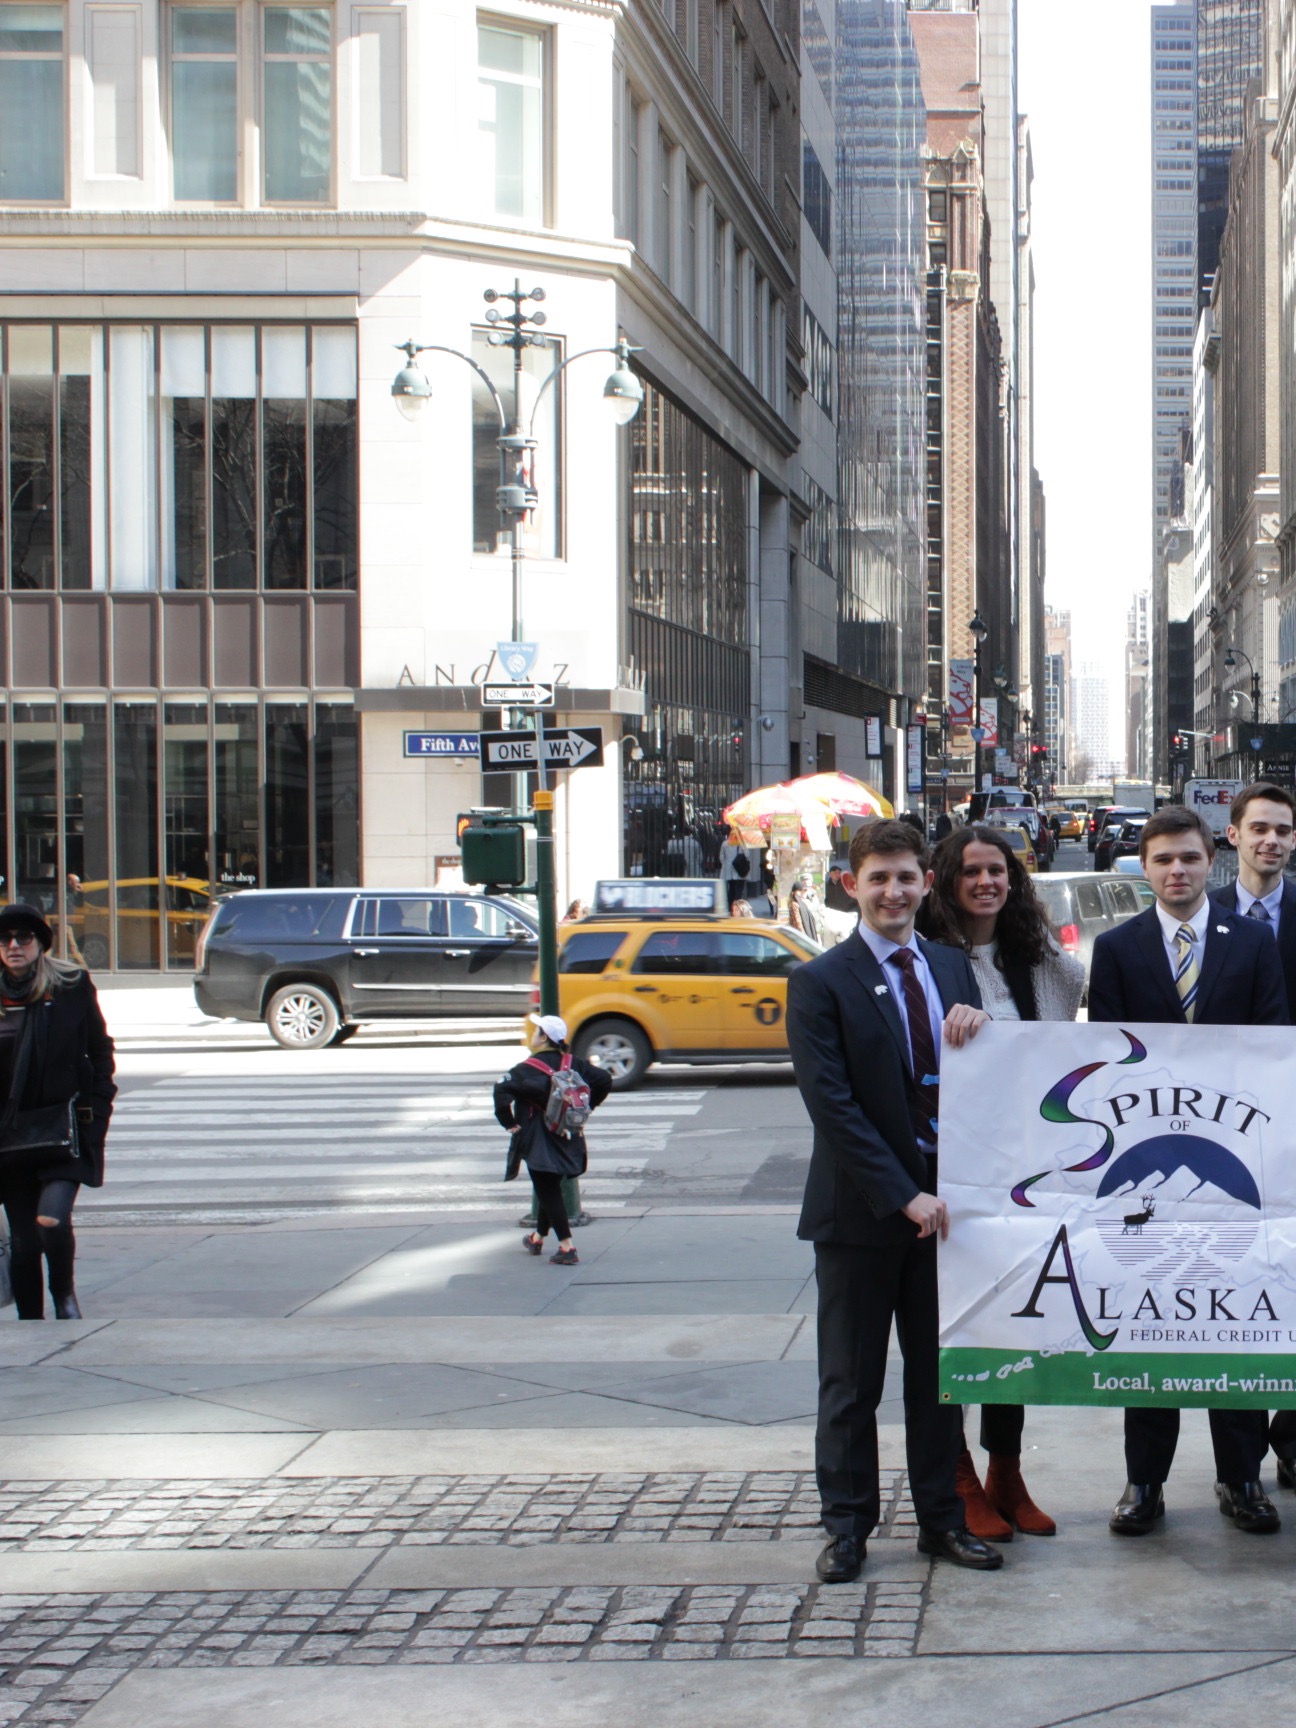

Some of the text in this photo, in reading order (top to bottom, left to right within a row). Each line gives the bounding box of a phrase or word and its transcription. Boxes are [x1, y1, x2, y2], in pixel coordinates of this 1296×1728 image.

[489, 689, 544, 698] ONE WAY
[420, 738, 480, 751] Fifth Av
[498, 741, 584, 760] ONE WAY
[221, 872, 256, 884] the shop
[1170, 1120, 1191, 1132] OF
[1011, 1224, 1281, 1351] ALASKA
[1129, 1329, 1211, 1342] FEDERAL
[1217, 1329, 1282, 1343] CREDIT
[1092, 1372, 1155, 1394] Local,
